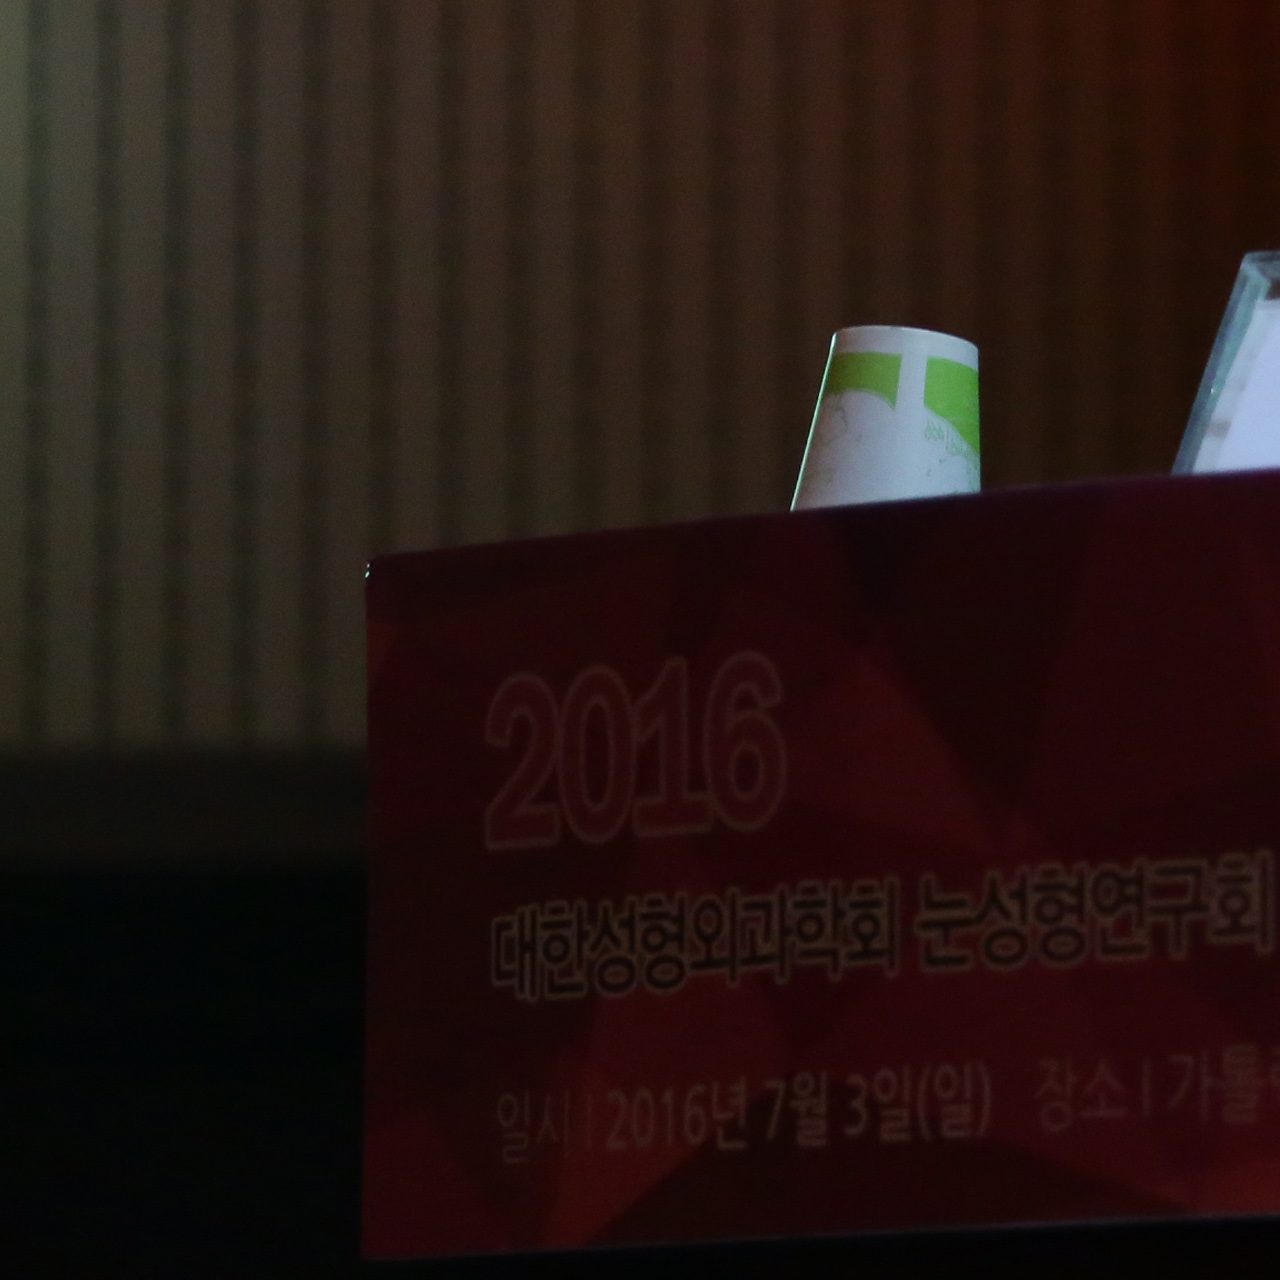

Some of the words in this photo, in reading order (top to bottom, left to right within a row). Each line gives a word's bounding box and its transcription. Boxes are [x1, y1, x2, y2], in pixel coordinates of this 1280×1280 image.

[484, 649, 788, 851] 2016
[490, 876, 902, 1003] 대한성형외과학회
[913, 849, 1275, 973] 눈성형연구회
[497, 1086, 570, 1164] 일시
[605, 1076, 749, 1152] 2016년
[762, 1070, 828, 1148] 7월
[843, 1060, 993, 1144] 3일(일)
[1034, 1054, 1128, 1136] 장소
